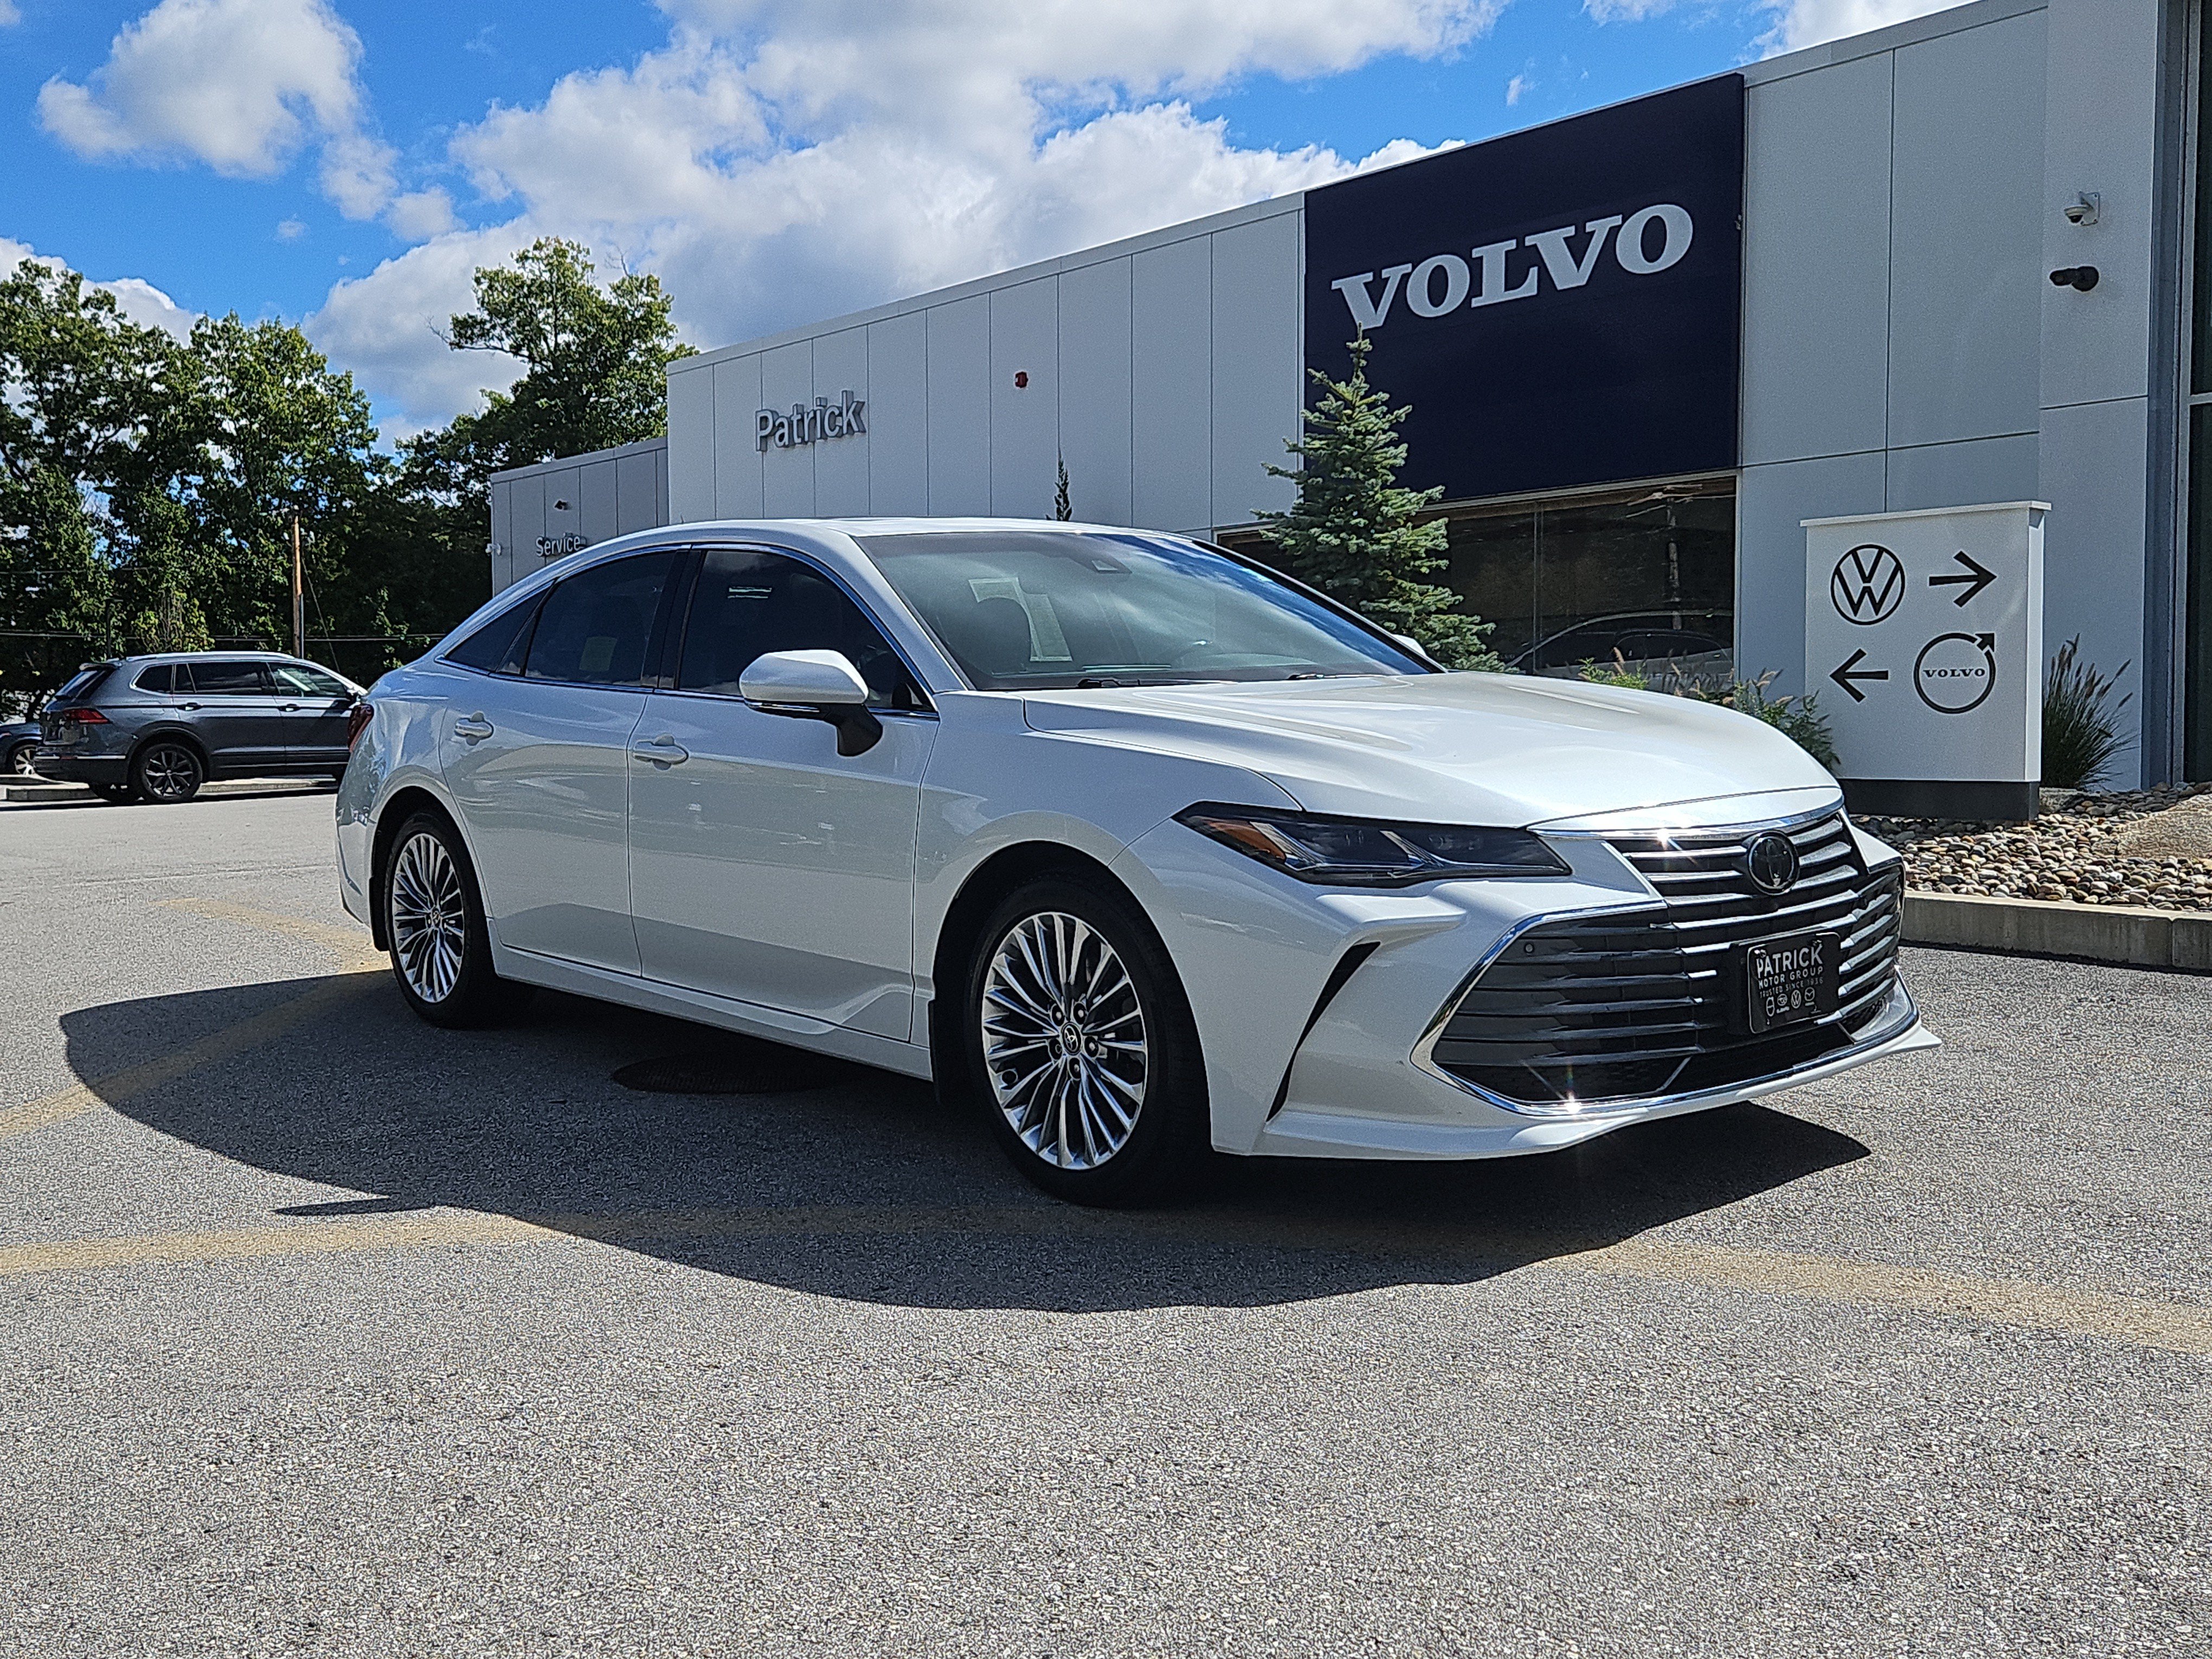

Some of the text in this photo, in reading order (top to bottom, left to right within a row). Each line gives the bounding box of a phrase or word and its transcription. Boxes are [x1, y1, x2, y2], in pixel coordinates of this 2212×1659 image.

[1331, 203, 1693, 331] VOLVO
[756, 390, 866, 452] Patrick
[535, 532, 584, 557] Service
[1835, 548, 1902, 618] VW
[1922, 668, 1985, 678] VOLVO
[1756, 943, 1823, 979] PATRICK
[1758, 966, 1823, 989] MOTOR GROUP
[1785, 980, 1804, 991] SINCE
